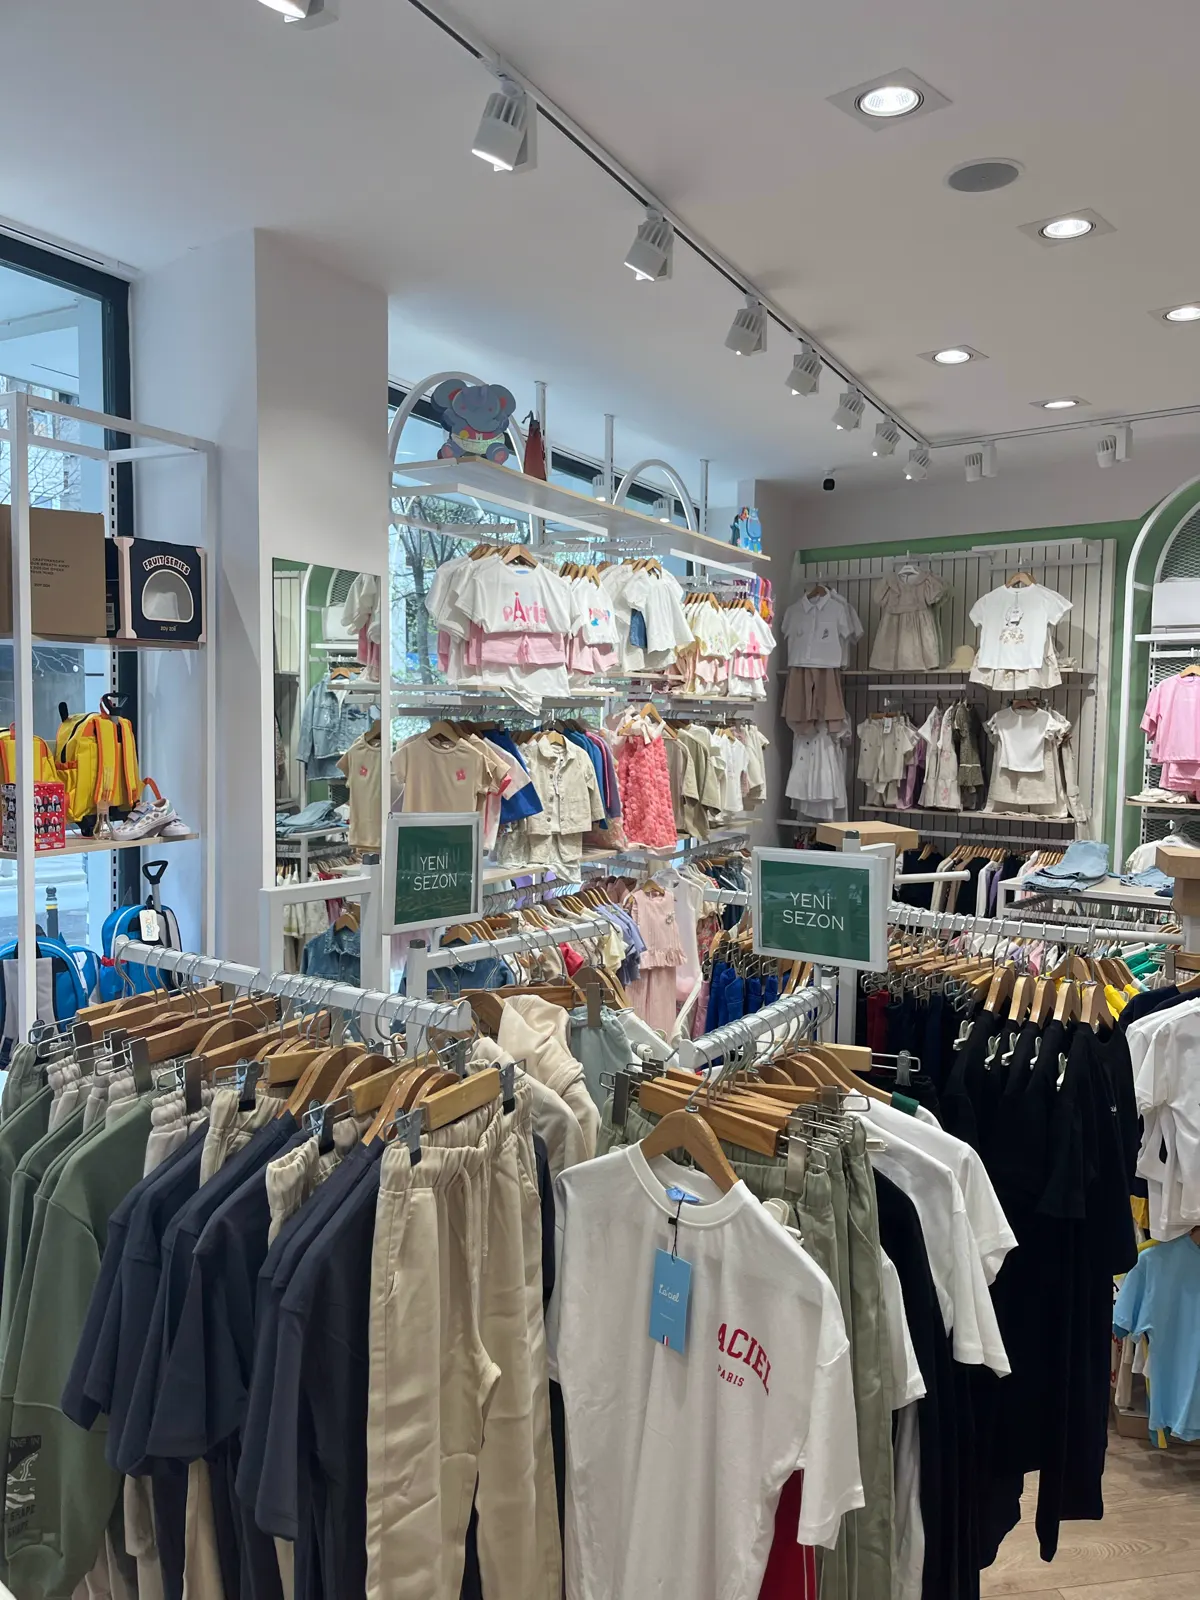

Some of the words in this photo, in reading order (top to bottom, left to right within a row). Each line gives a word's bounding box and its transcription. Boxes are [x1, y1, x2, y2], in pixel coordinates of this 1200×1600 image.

[143, 555, 165, 571] FRUIT
[165, 555, 190, 575] SERIES
[420, 852, 449, 871] YENİ
[413, 872, 458, 891] SEZON
[789, 891, 831, 910] YENİ
[782, 909, 845, 931] SEZON
